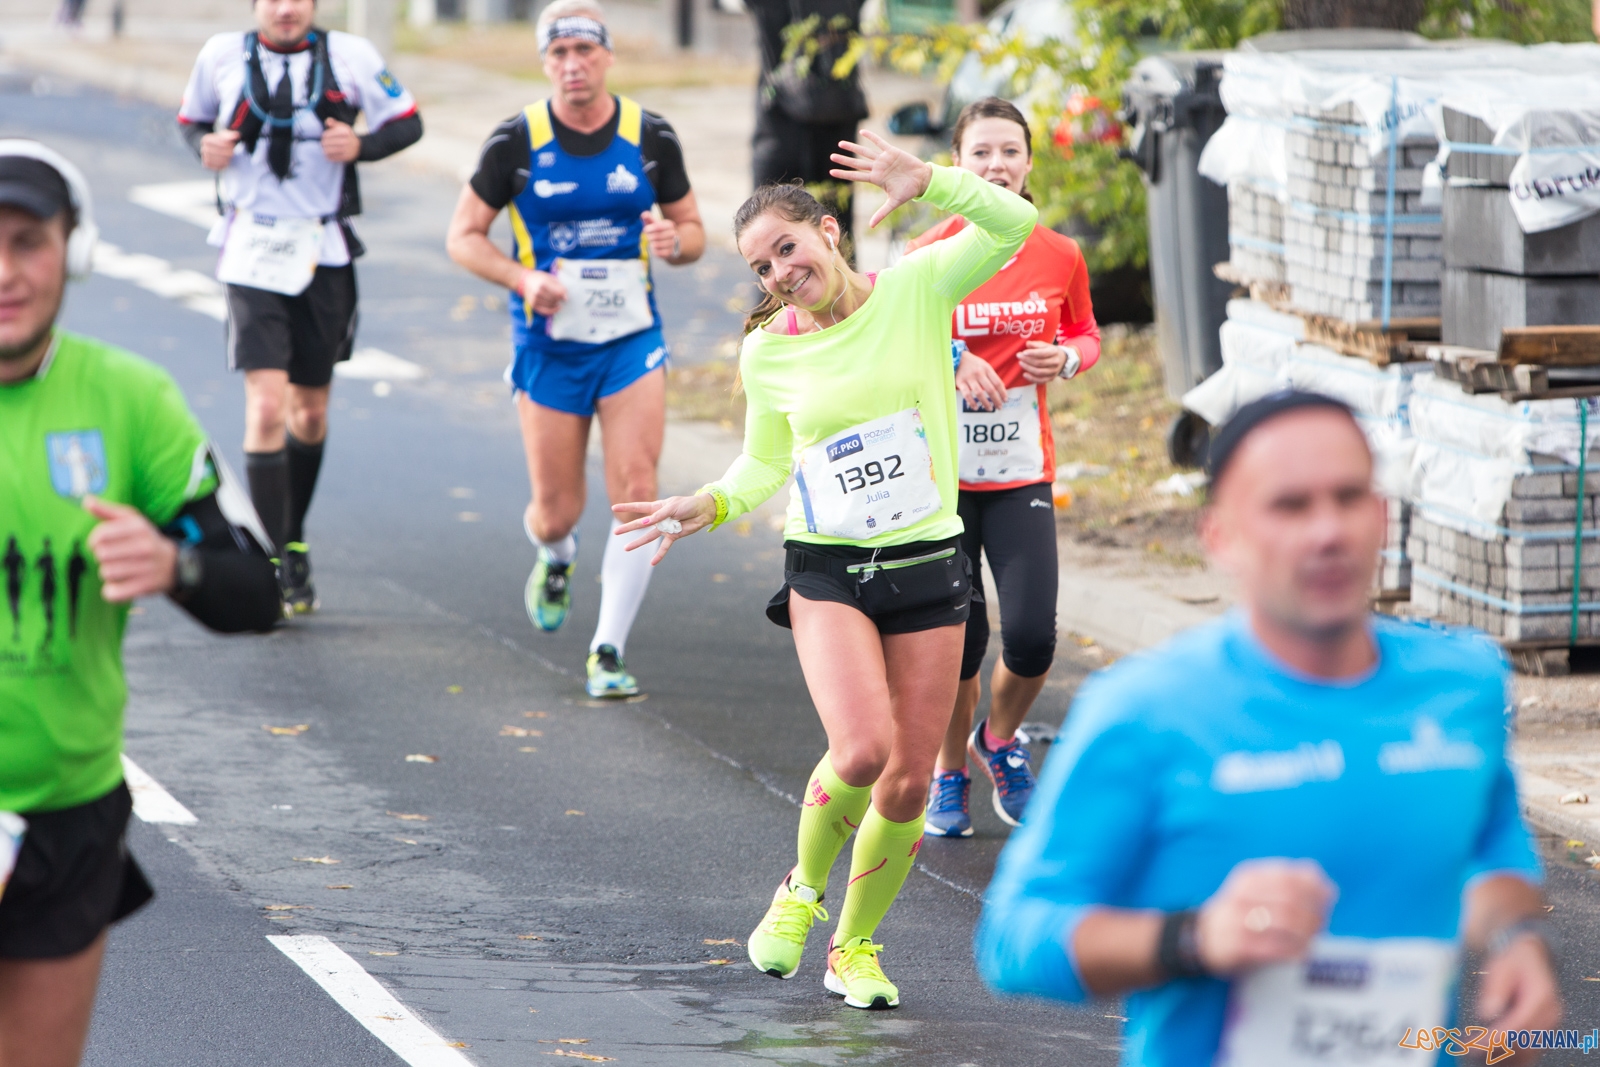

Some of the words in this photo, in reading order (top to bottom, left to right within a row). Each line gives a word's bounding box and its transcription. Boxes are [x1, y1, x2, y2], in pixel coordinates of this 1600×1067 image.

[584, 289, 626, 308] 756
[976, 299, 1048, 317] NETBOX
[993, 316, 1046, 339] biega
[964, 421, 1020, 443] 1802
[835, 454, 905, 494] 1392
[865, 490, 891, 504] Julia
